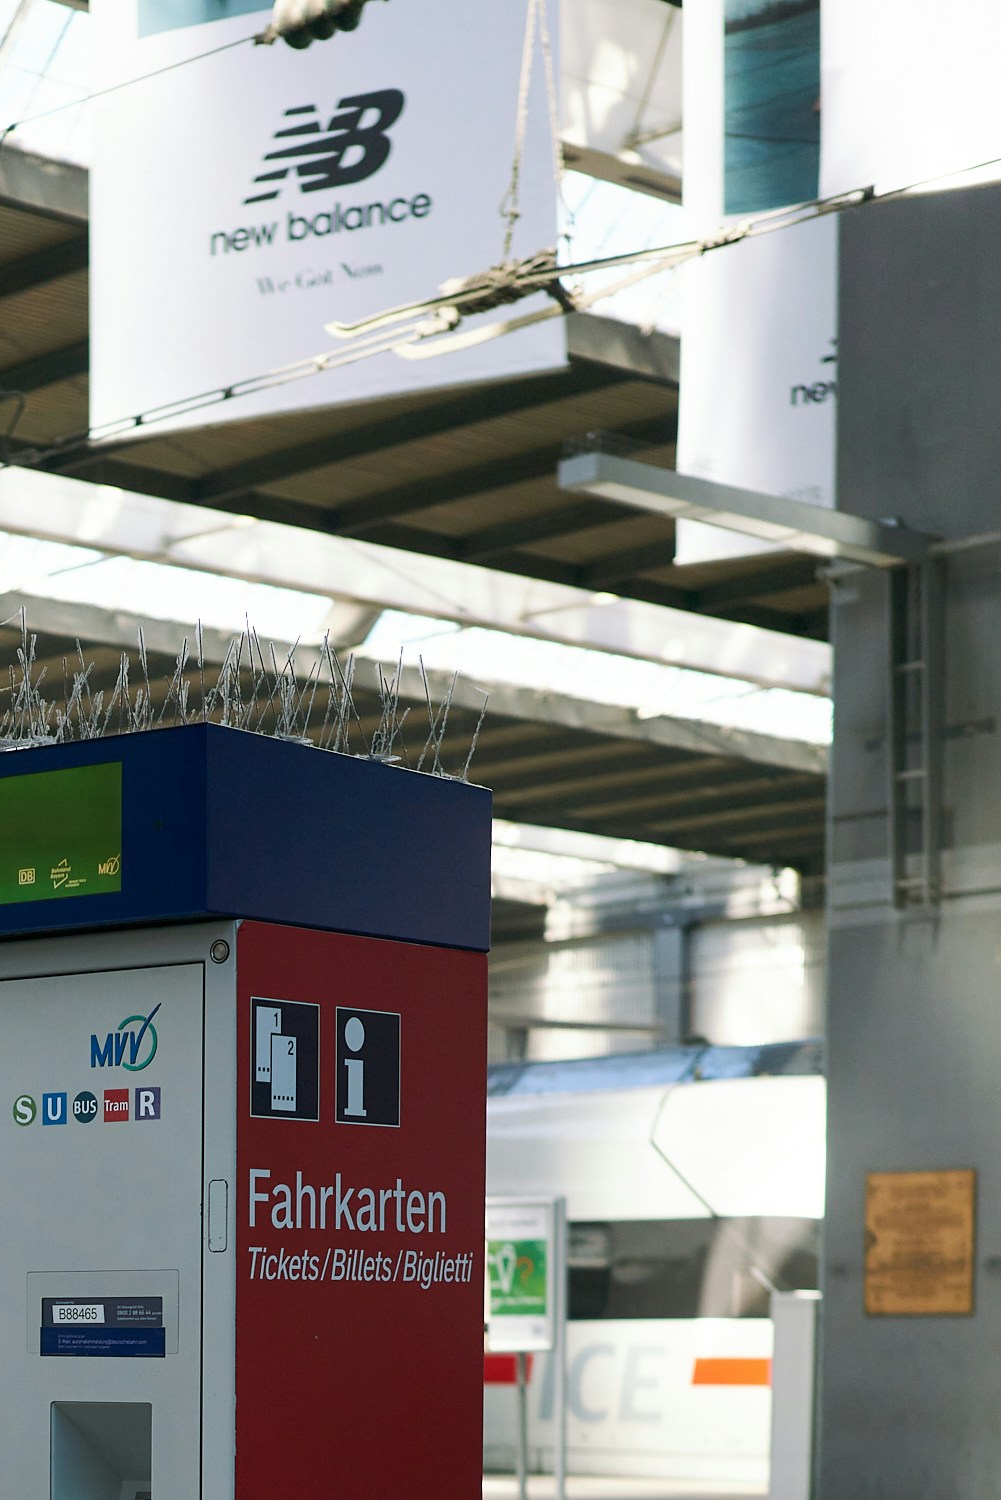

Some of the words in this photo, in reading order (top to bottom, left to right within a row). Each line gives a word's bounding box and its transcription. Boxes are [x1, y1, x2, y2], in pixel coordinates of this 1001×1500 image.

[210, 221, 278, 256] new
[286, 192, 432, 242] balance
[20, 869, 35, 883] DB
[90, 1003, 162, 1070] MVV
[273, 1012, 279, 1027] 1
[287, 1040, 294, 1056] 2
[15, 1097, 34, 1125] S
[47, 1097, 62, 1121] U
[73, 1099, 97, 1115] BUS
[104, 1099, 129, 1113] Tram
[139, 1090, 155, 1117] R
[248, 1168, 447, 1233] Fahrkarten
[248, 1246, 474, 1290] Tickets/Billets/Biglietti
[58, 1307, 97, 1320] B88465
[536, 1343, 667, 1423] ICE
